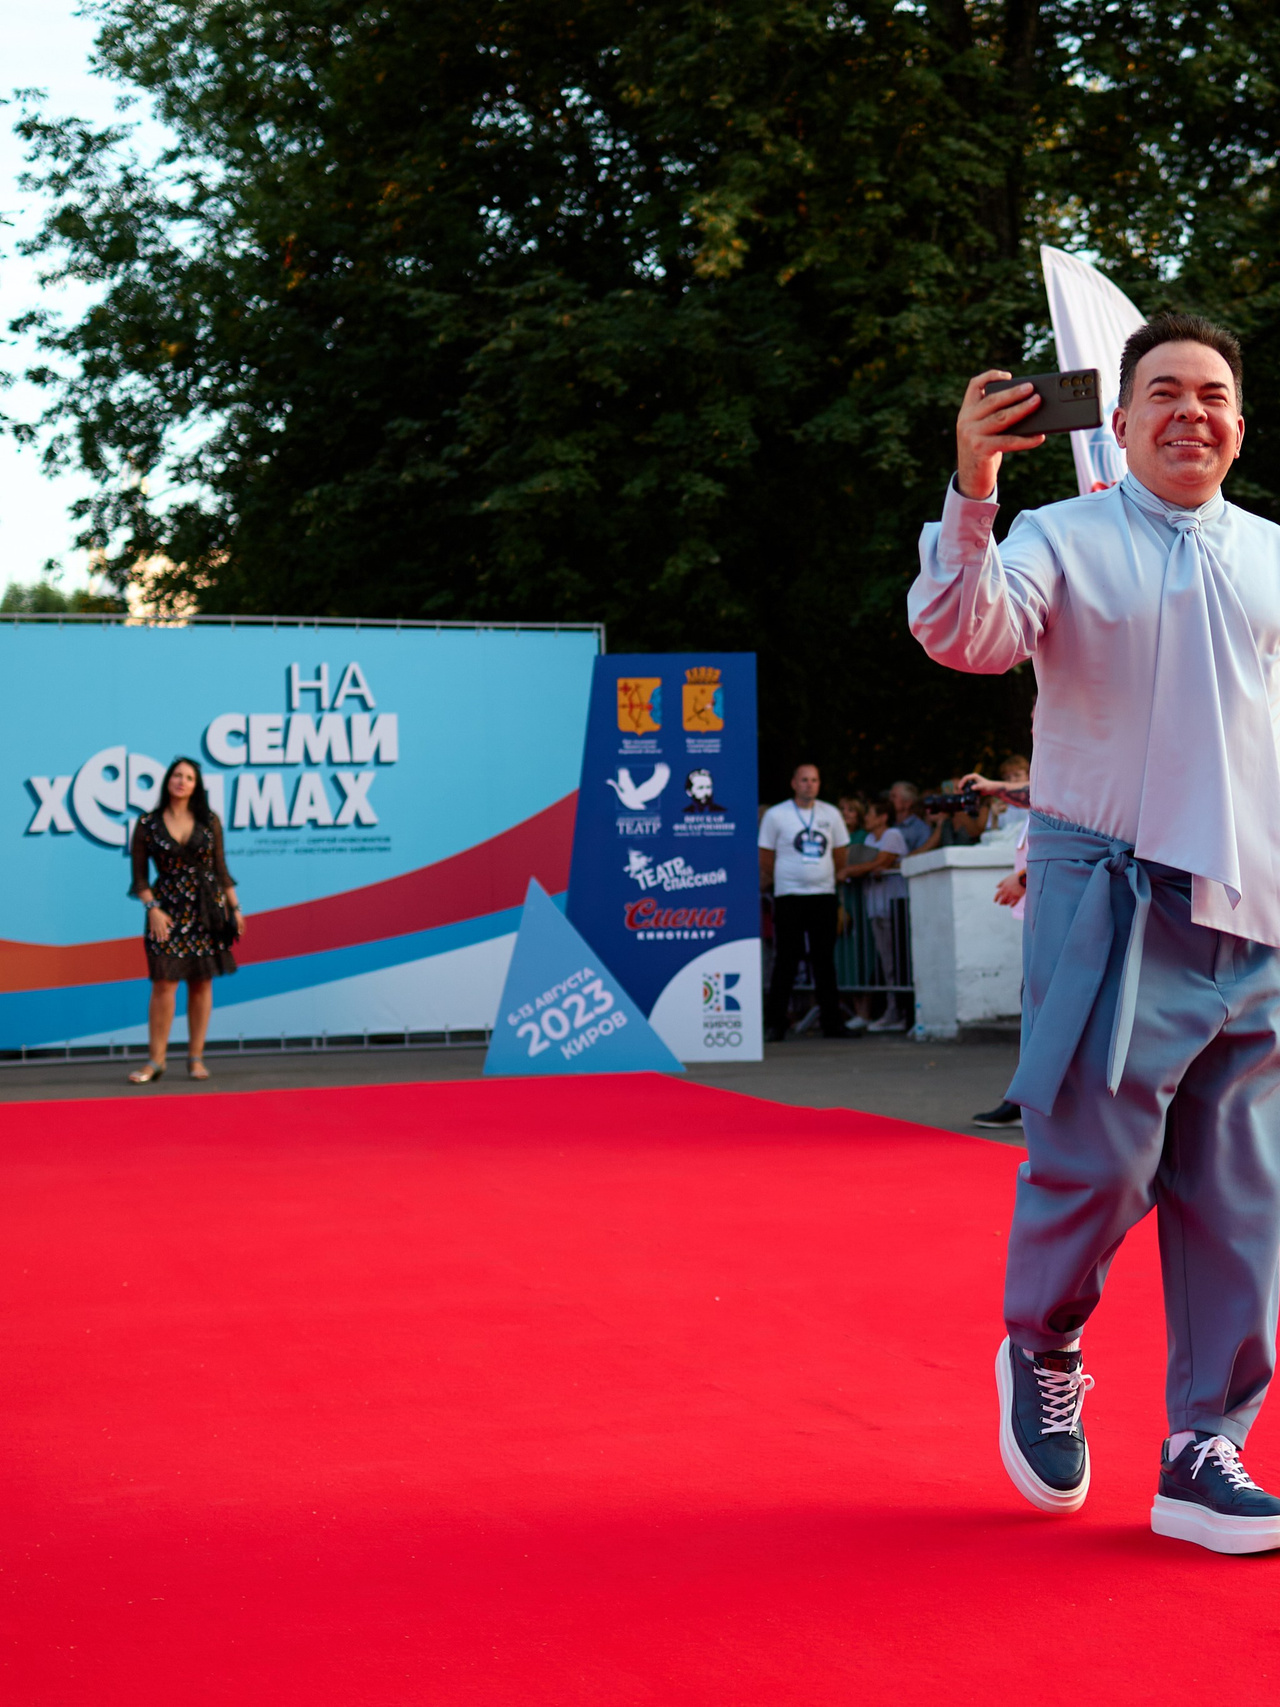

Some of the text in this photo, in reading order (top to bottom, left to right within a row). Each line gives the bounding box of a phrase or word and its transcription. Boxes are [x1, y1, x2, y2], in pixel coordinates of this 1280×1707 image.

[286, 661, 377, 711] НА
[203, 713, 399, 767] СЕМИ
[616, 819, 662, 835] ТЕАТР
[634, 857, 685, 891] ТЕАТР
[663, 867, 728, 892] СПАССКОЙ
[624, 897, 727, 931] Смена
[636, 930, 716, 941] КИНОТЕАТР
[534, 967, 596, 1011] АВГУСТА
[516, 979, 614, 1058] 2023
[560, 1010, 629, 1061] КИРОВ
[703, 1031, 742, 1048] 650
